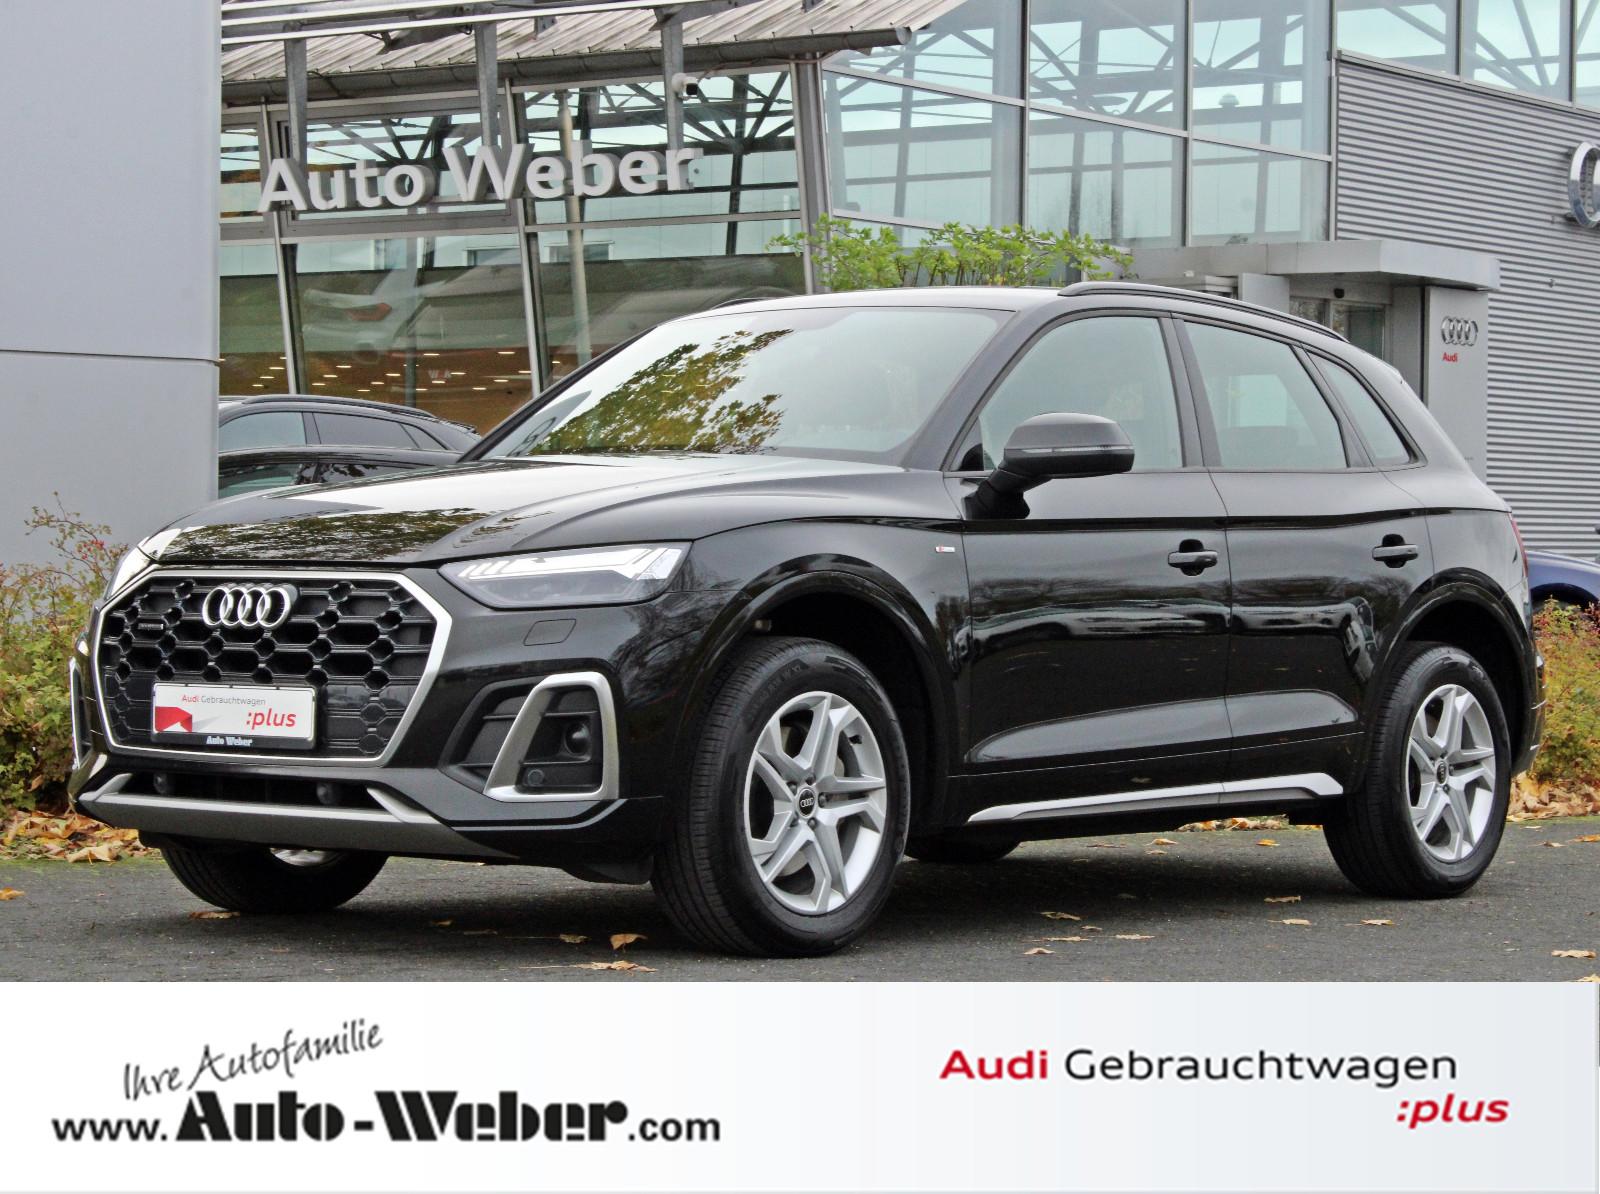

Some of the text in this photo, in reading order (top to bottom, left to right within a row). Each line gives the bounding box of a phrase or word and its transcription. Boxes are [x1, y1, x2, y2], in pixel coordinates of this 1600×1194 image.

[257, 139, 702, 212] Auto Weber
[1442, 352, 1458, 362] Audi
[181, 694, 266, 706] Audi Gebrauchtwagen
[246, 708, 297, 730] :plus
[206, 735, 253, 746] Auto Weber
